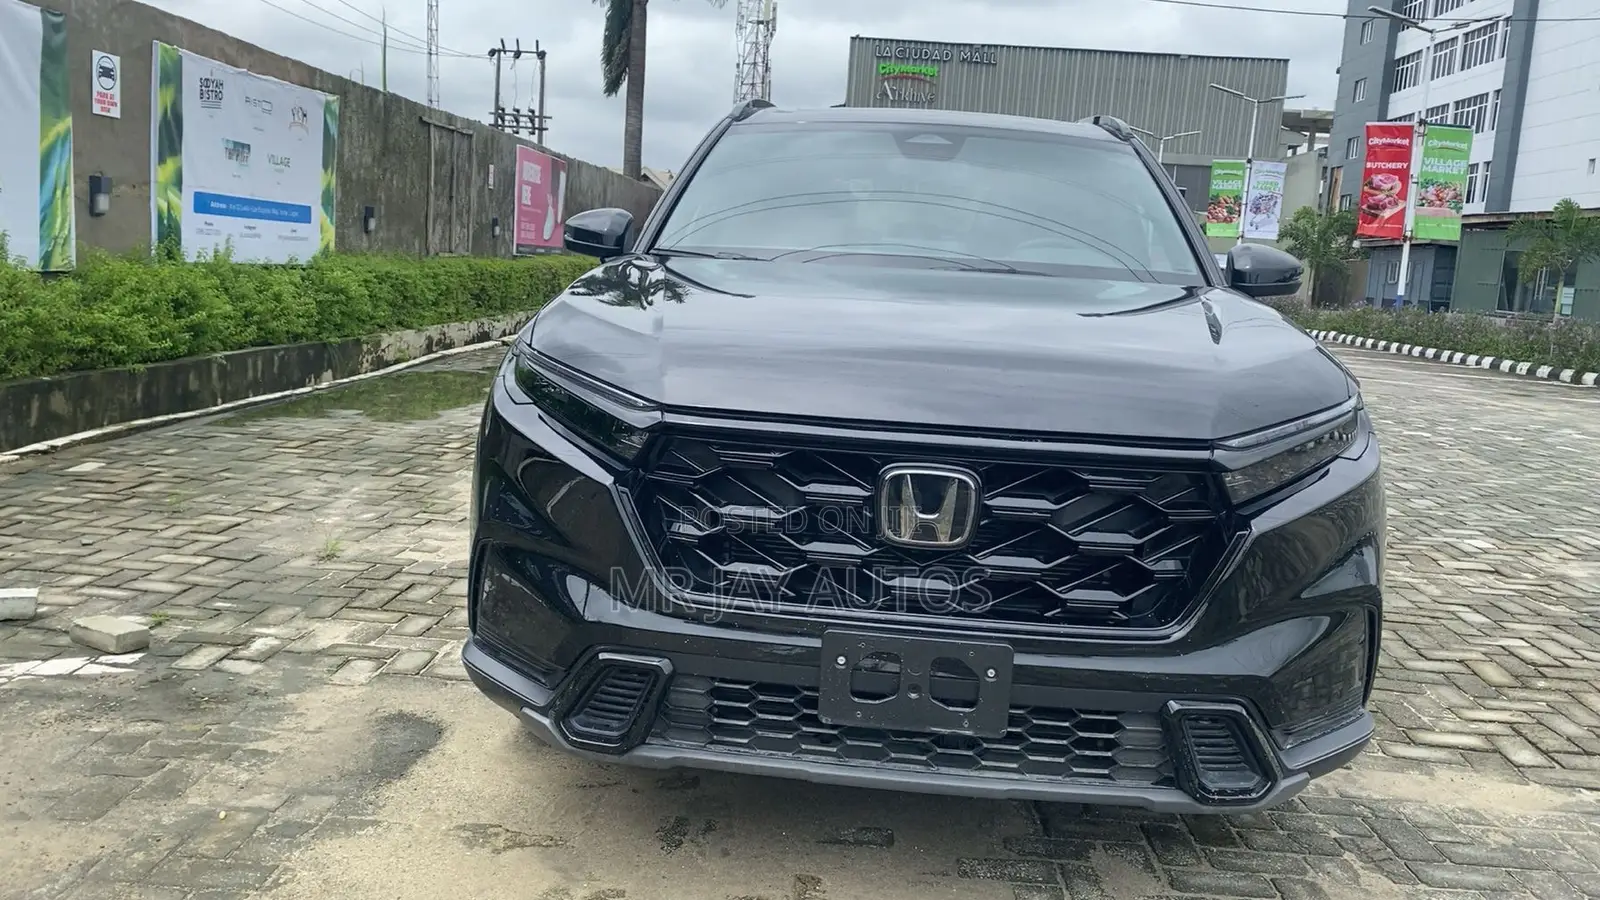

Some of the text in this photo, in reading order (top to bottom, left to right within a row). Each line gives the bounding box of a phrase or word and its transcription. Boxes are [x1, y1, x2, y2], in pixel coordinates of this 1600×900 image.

[876, 46, 997, 64] LA CIUDAD MALL
[199, 89, 224, 101] BISTRO
[1368, 137, 1410, 147] CityMarket
[1428, 139, 1468, 150] CityMarket
[266, 152, 291, 169] VILLAGE
[1423, 157, 1467, 168] VILLAGE
[1422, 165, 1467, 175] MARKET
